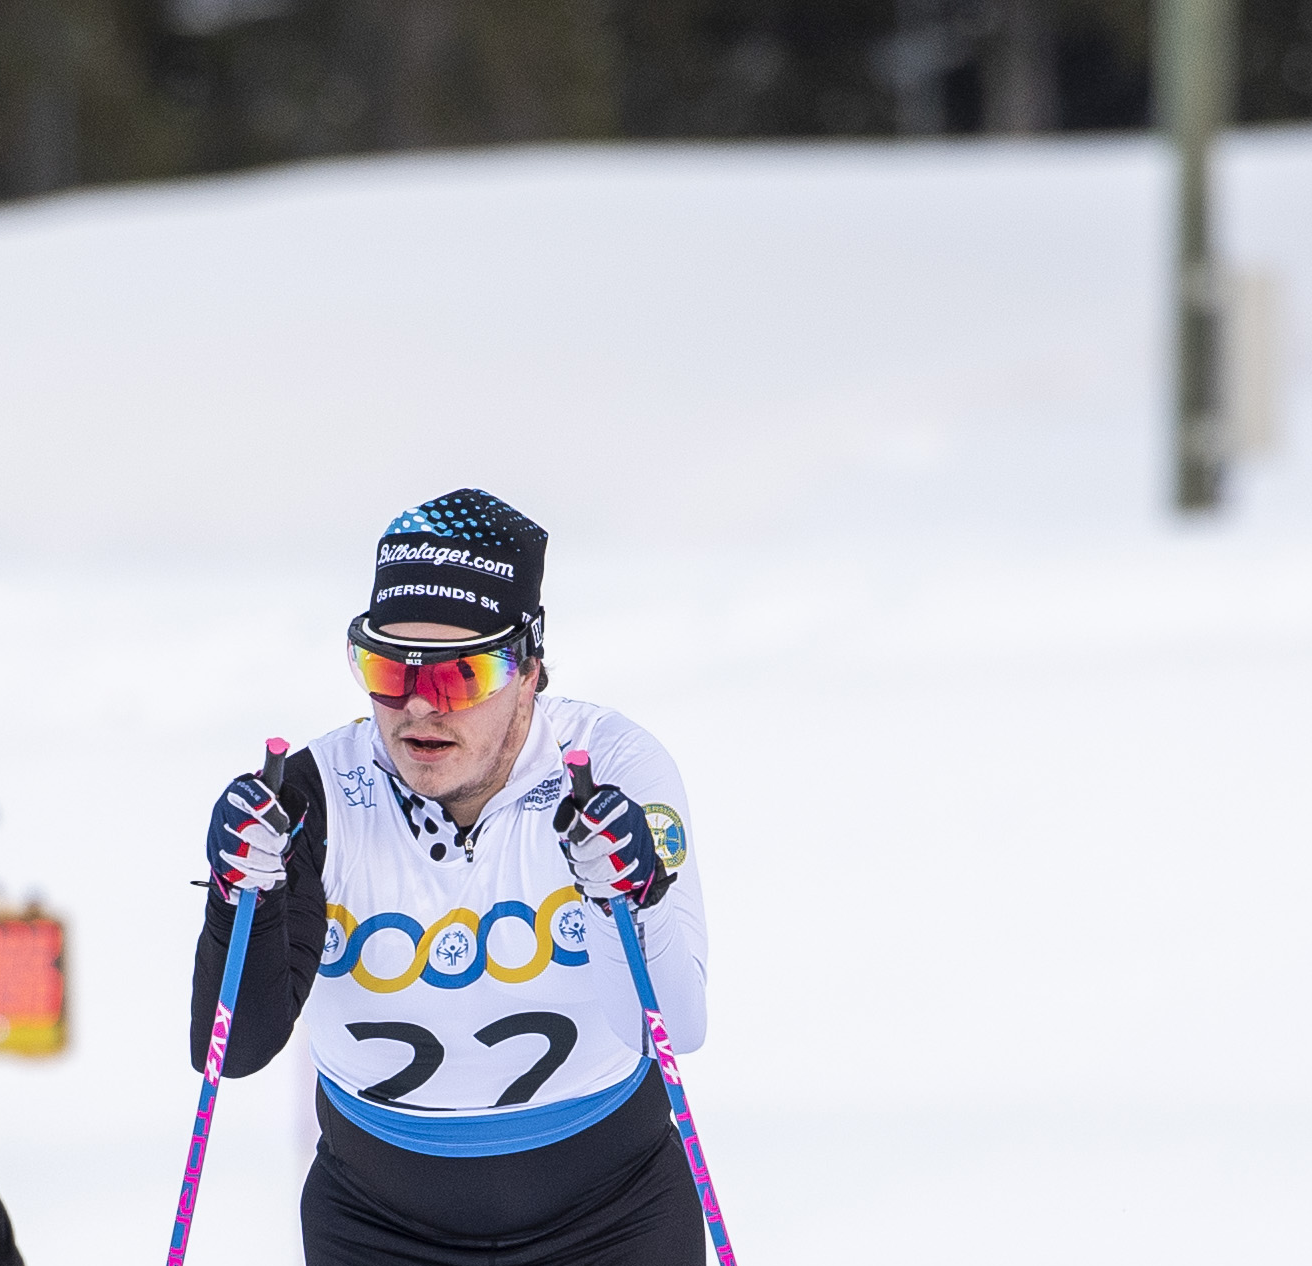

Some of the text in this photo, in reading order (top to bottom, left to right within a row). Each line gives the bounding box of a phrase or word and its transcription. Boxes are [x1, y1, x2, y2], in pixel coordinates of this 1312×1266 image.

[377, 542, 515, 578] Bilbolaget.com
[376, 584, 500, 613] ÖSTERSUNDS SK
